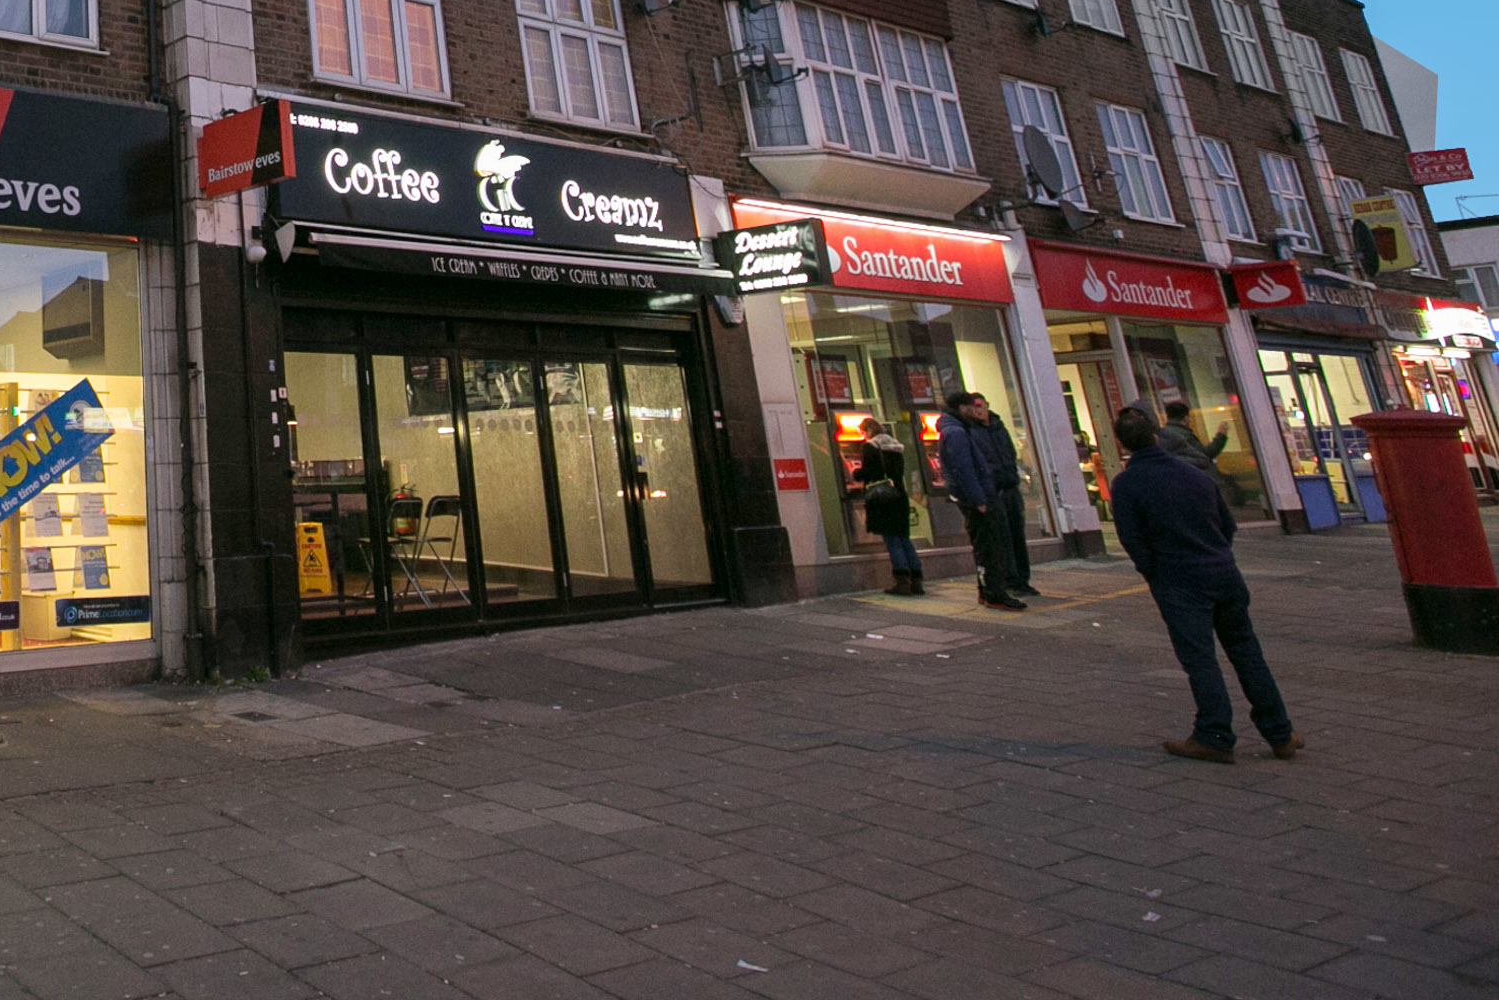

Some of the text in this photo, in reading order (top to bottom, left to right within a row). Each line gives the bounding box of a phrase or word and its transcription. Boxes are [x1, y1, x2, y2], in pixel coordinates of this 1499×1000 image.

[208, 151, 281, 182] Bairstow eves
[325, 148, 440, 203] Coffee
[561, 180, 664, 232] Creamz
[735, 225, 798, 254] Dessert
[431, 257, 446, 272] ICE
[448, 259, 477, 275] CREAM
[487, 262, 520, 279] WAFFLES
[569, 268, 599, 285] COFFEE
[610, 273, 629, 287] MANY
[631, 273, 656, 289] MORE
[739, 252, 802, 276] Lounge
[843, 236, 964, 285] Santander
[1107, 270, 1193, 309] Santander
[1300, 283, 1326, 303] LAL
[1, 497, 19, 512] the
[17, 482, 40, 498] time
[39, 472, 50, 484] to
[50, 456, 76, 475] talk...
